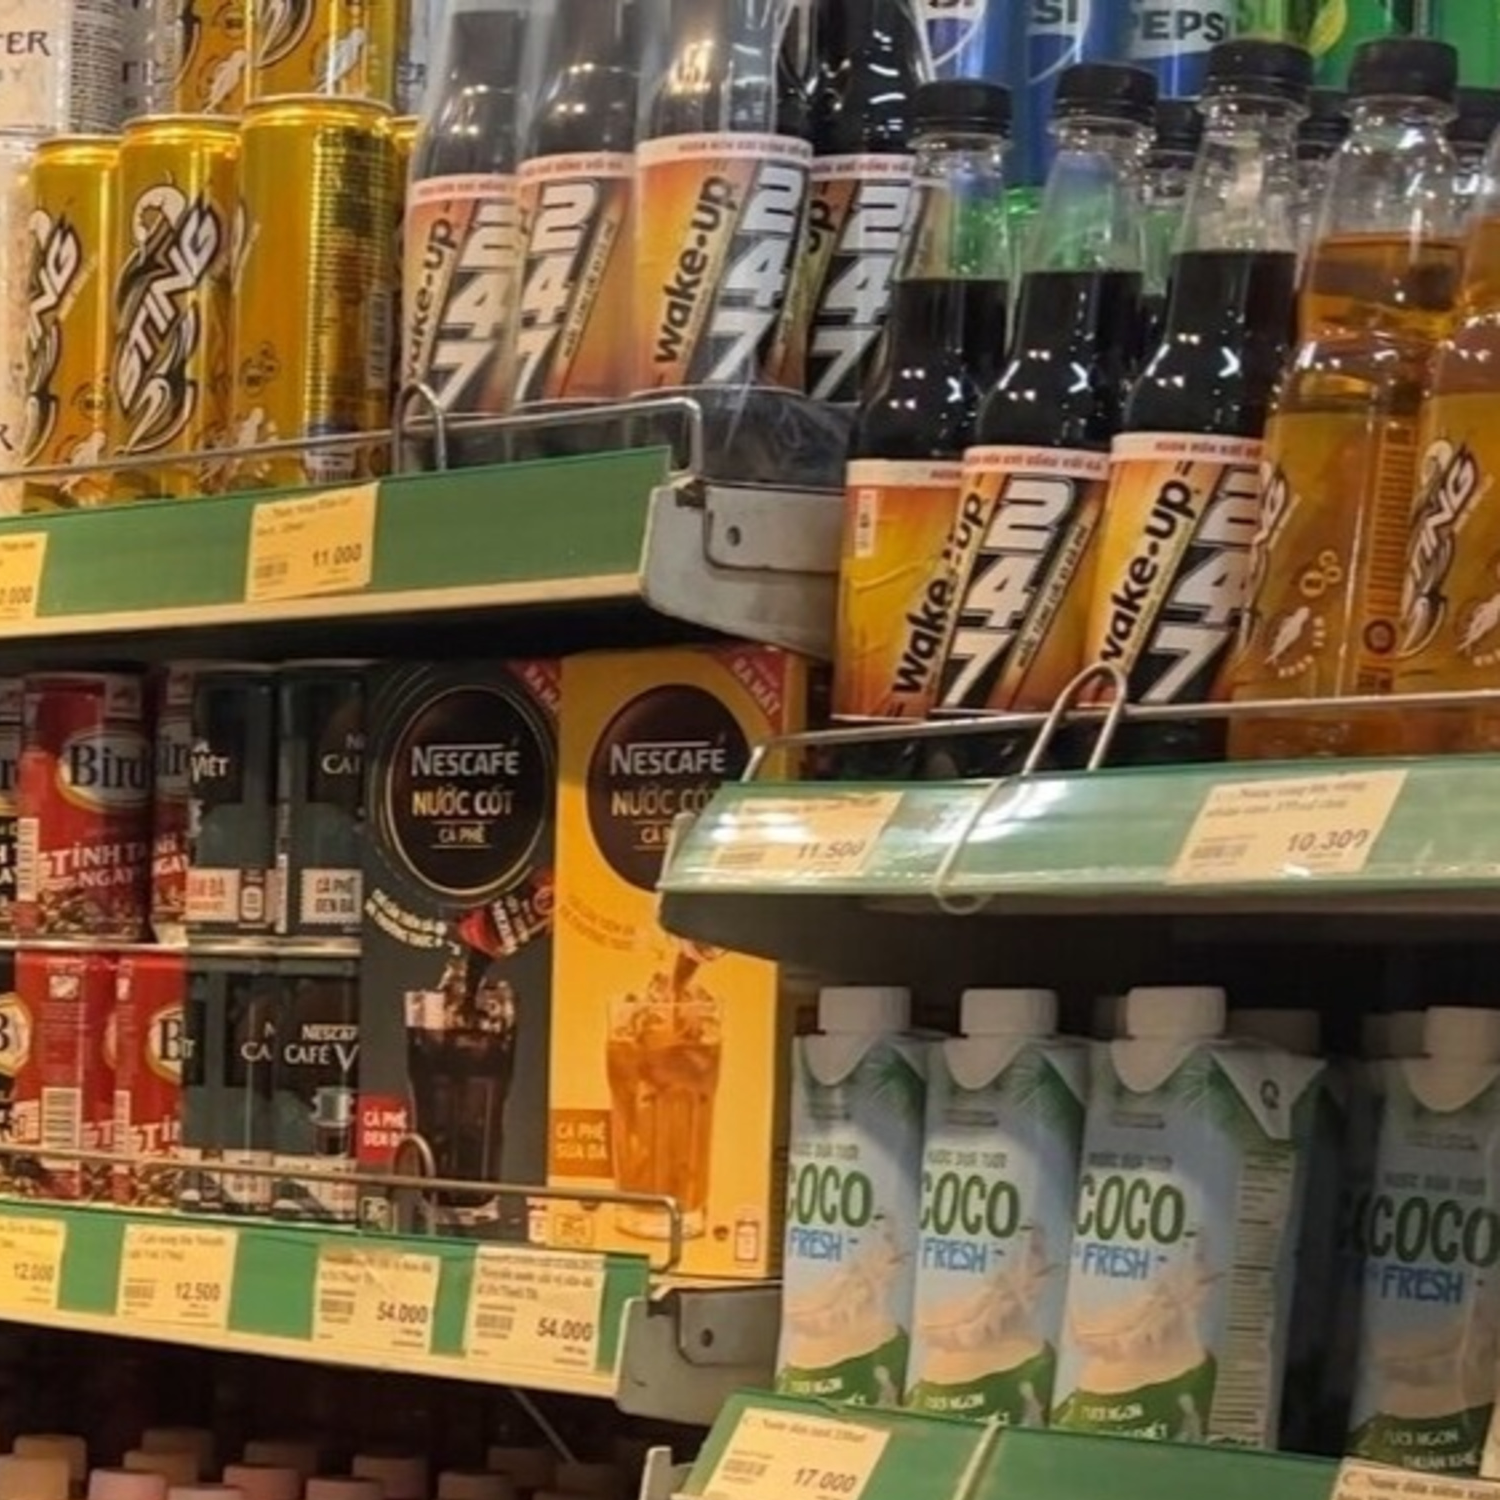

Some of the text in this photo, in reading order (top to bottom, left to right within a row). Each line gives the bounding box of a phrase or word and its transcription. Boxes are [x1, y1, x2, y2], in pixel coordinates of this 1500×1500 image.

[655, 175, 739, 365] wake-up
[703, 162, 804, 384] 247
[120, 200, 219, 412] STING
[940, 477, 1075, 707] 247
[922, 1236, 987, 1273] FRESH
[1082, 1242, 1150, 1280] FRESH
[1382, 1264, 1464, 1304] FRESH
[376, 1300, 429, 1324] 54.000
[536, 1316, 594, 1342] 54.000
[793, 1467, 859, 1494] 17.000
